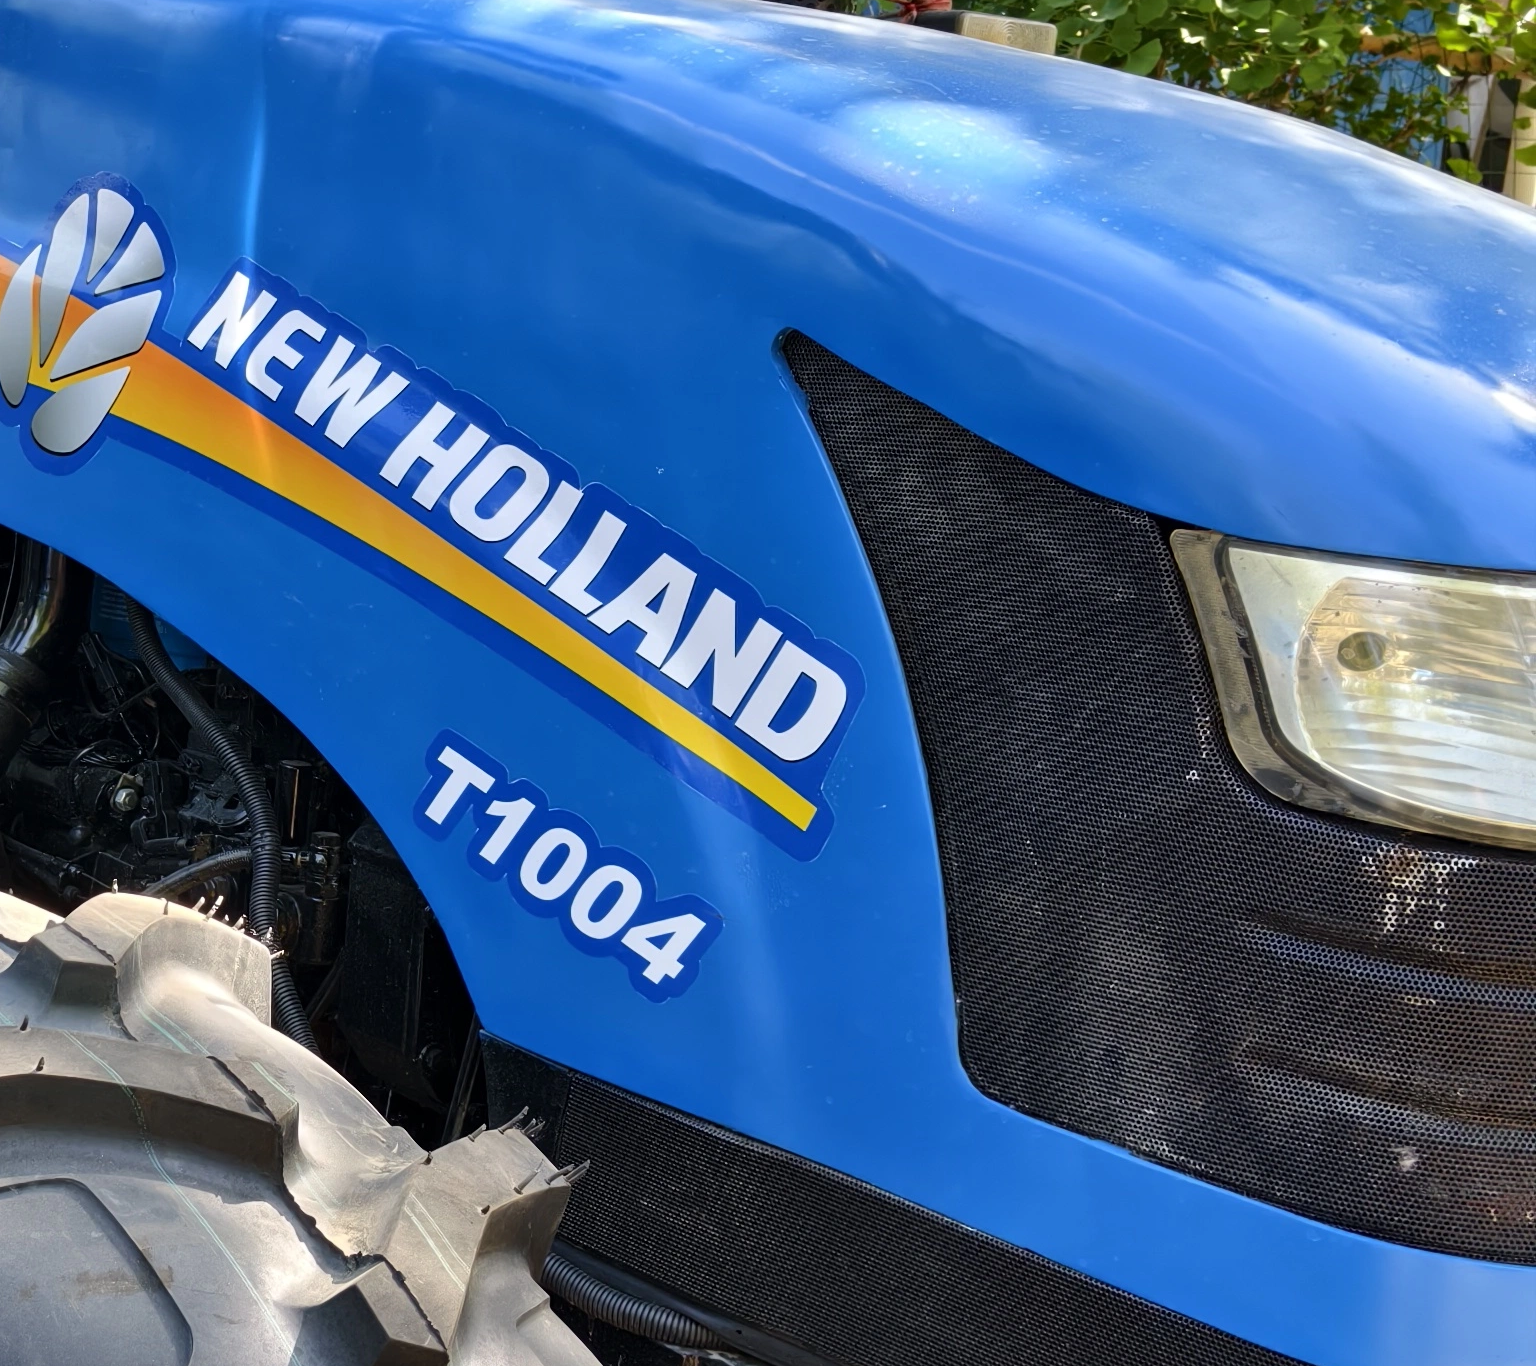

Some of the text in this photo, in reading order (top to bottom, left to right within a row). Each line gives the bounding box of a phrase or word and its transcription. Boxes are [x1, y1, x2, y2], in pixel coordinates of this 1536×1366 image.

[186, 270, 848, 762] NEW HOLLAND
[422, 743, 707, 986] T1004
